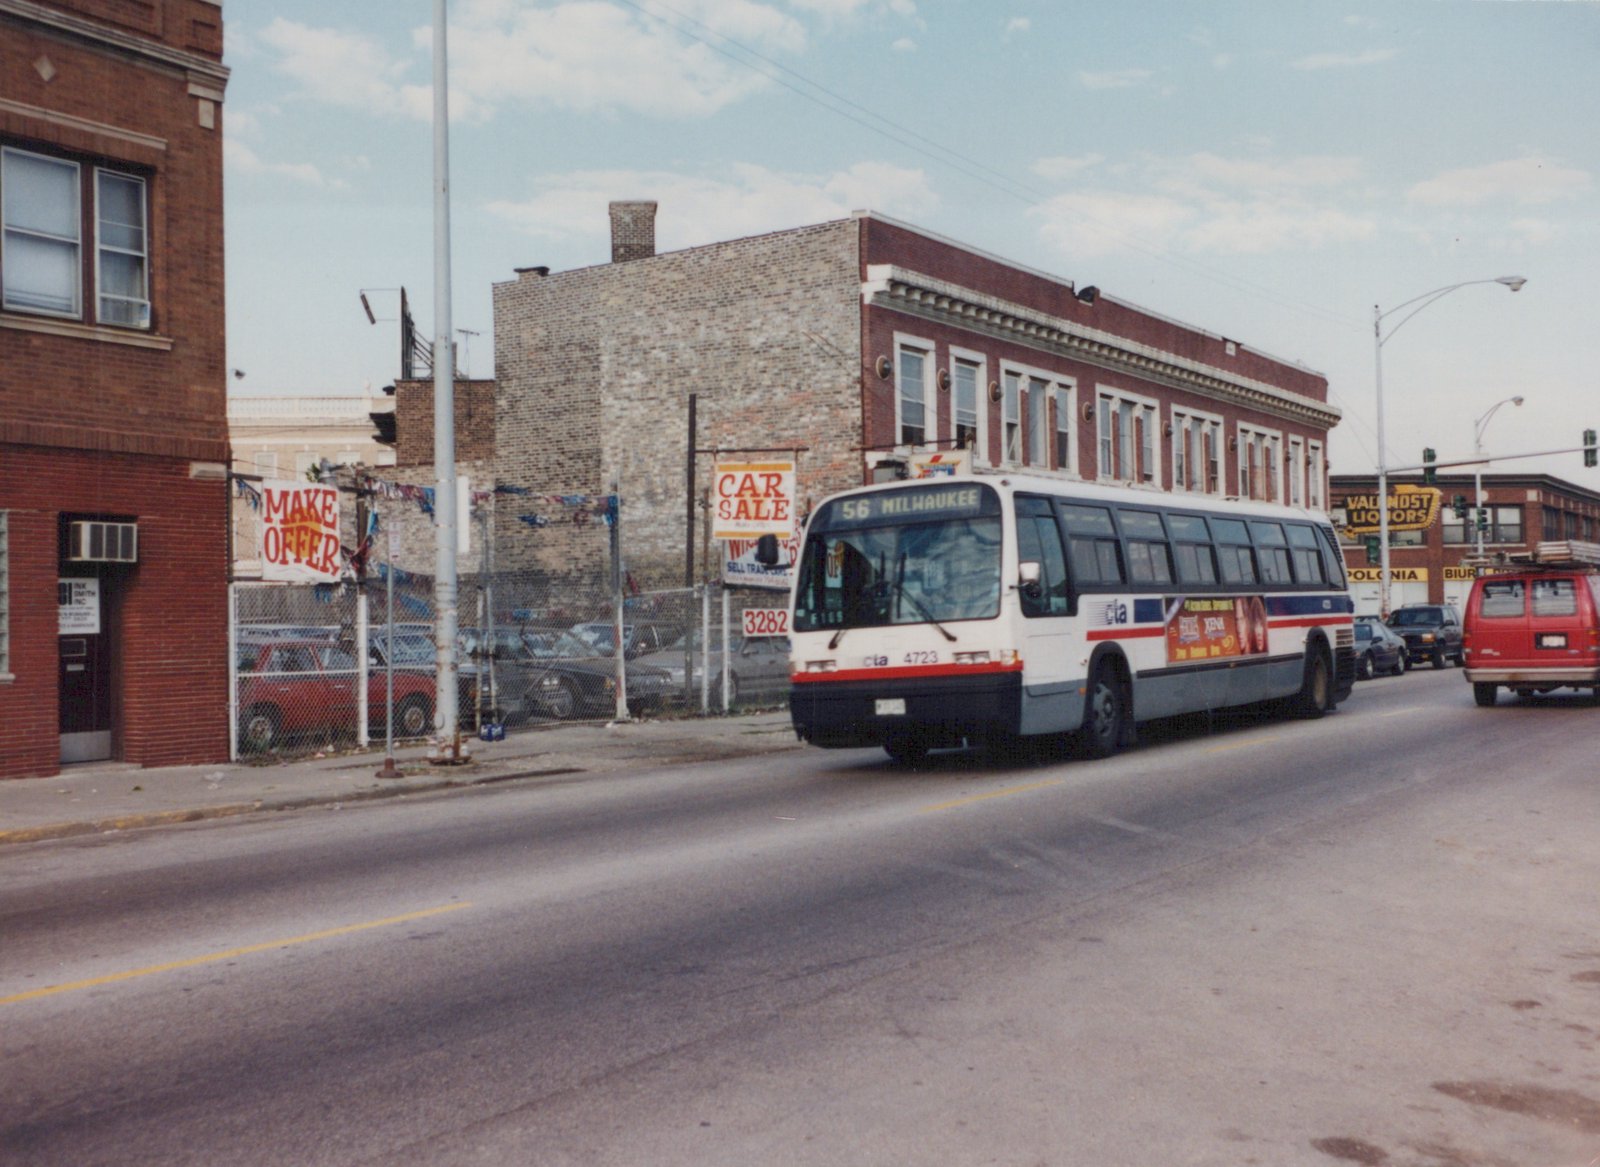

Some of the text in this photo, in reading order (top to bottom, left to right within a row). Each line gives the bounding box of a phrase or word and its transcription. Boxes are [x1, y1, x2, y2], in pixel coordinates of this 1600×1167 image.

[718, 472, 785, 498] CAR
[264, 488, 338, 531] MAKE
[718, 499, 790, 521] SALE
[842, 489, 977, 520] 56 MILWAUKEE
[264, 526, 340, 577] OFFER
[727, 561, 745, 574] SELL
[1444, 568, 1477, 579] BIUR
[744, 609, 789, 634] 3282
[863, 650, 939, 668] cta 4723
